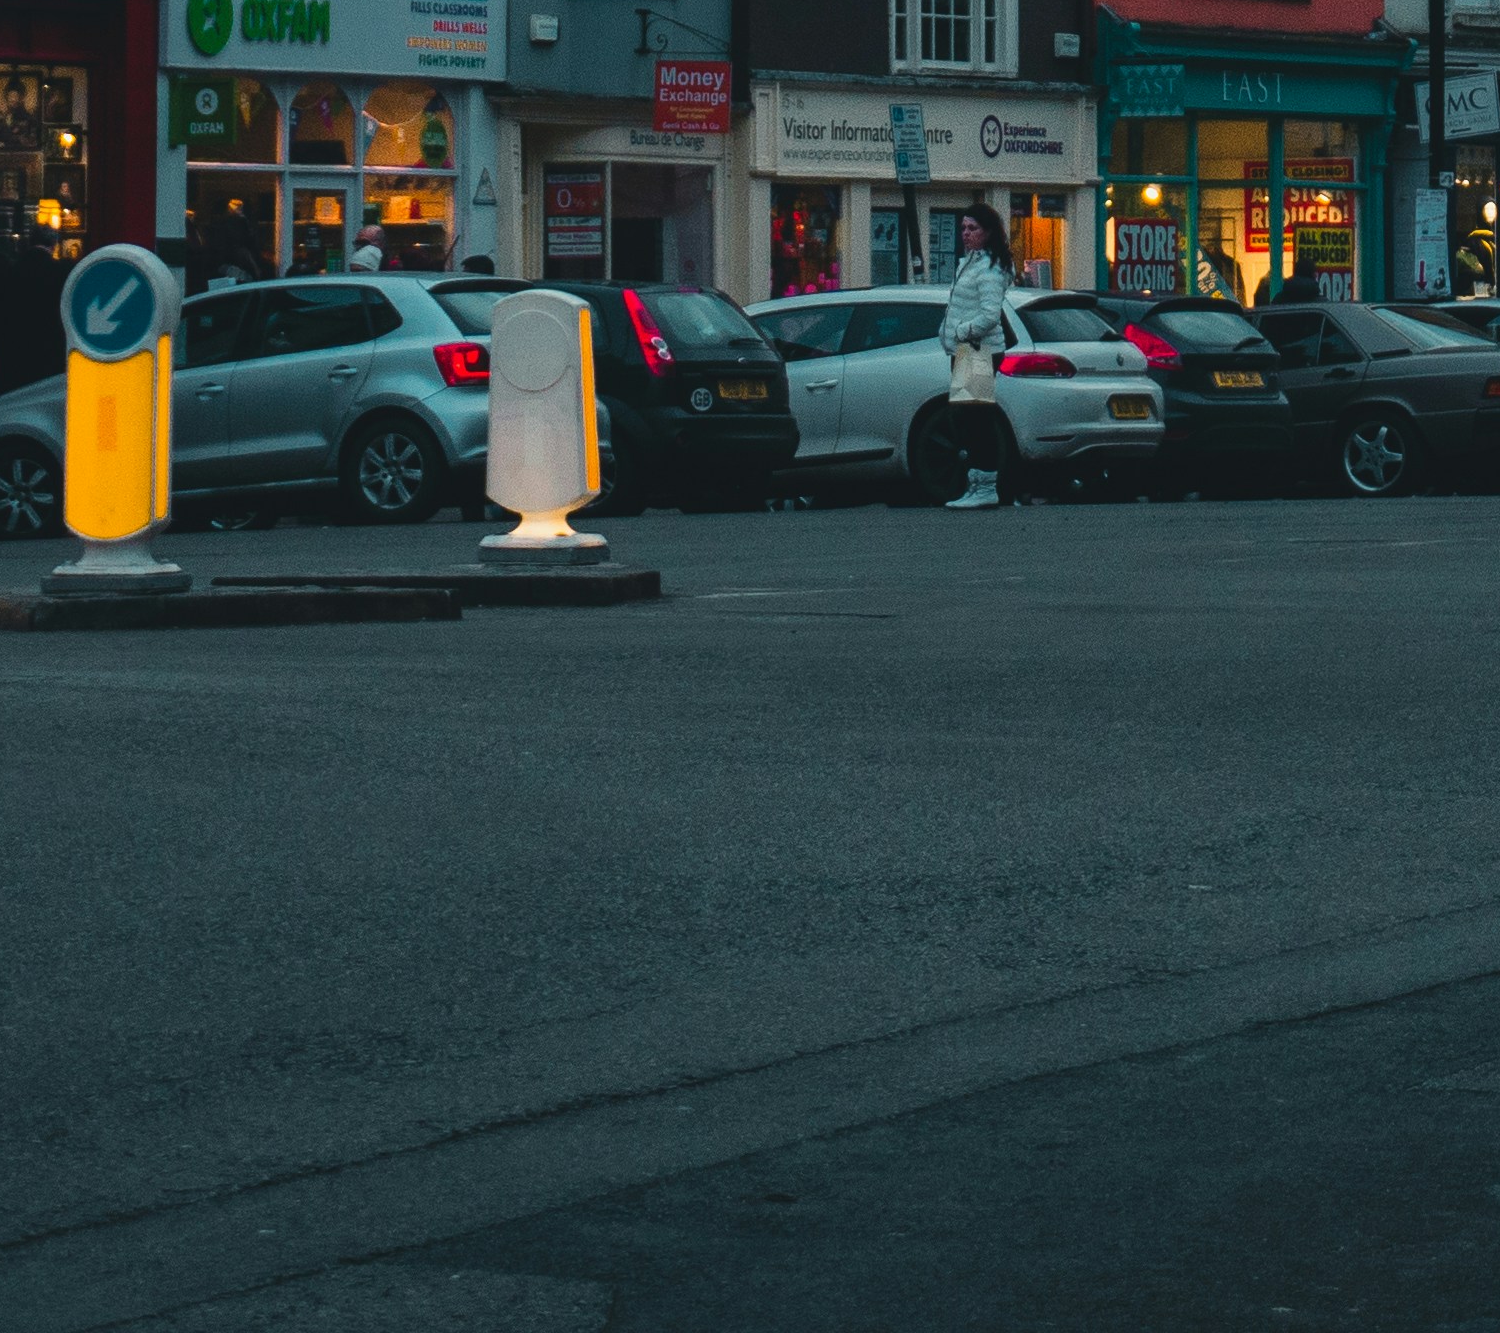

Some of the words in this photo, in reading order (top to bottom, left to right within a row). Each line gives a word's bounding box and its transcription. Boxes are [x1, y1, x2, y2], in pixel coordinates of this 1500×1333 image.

[411, 1, 431, 13] FILLS
[434, 3, 487, 17] CLASSROOMS
[434, 20, 460, 33] DRILLS
[462, 21, 488, 35] WELLS
[455, 39, 487, 52] WOMEN
[419, 54, 448, 67] FIGHTS
[450, 55, 486, 69] POVERTY
[660, 66, 725, 91] Money
[1127, 77, 1177, 95] EAST
[1222, 70, 1284, 104] EAST
[659, 88, 727, 106] Exchange
[1426, 87, 1488, 117] MC
[190, 121, 225, 135] OXFAM
[782, 118, 827, 141] Visitor
[831, 119, 895, 143] Informatio
[1004, 122, 1047, 139] Experience
[630, 130, 659, 146] Bureau
[660, 133, 671, 145] de
[675, 133, 705, 151] Change
[1004, 141, 1063, 155] OXFORDSHIRE
[783, 148, 895, 163] www.experienceoxfordshir
[1292, 165, 1348, 178] CLOSING!
[1118, 224, 1177, 262] STORE
[1301, 232, 1317, 244] ALL
[1321, 231, 1349, 245] STOCK
[1117, 263, 1176, 291] CLOSING
[694, 391, 711, 407] GB
